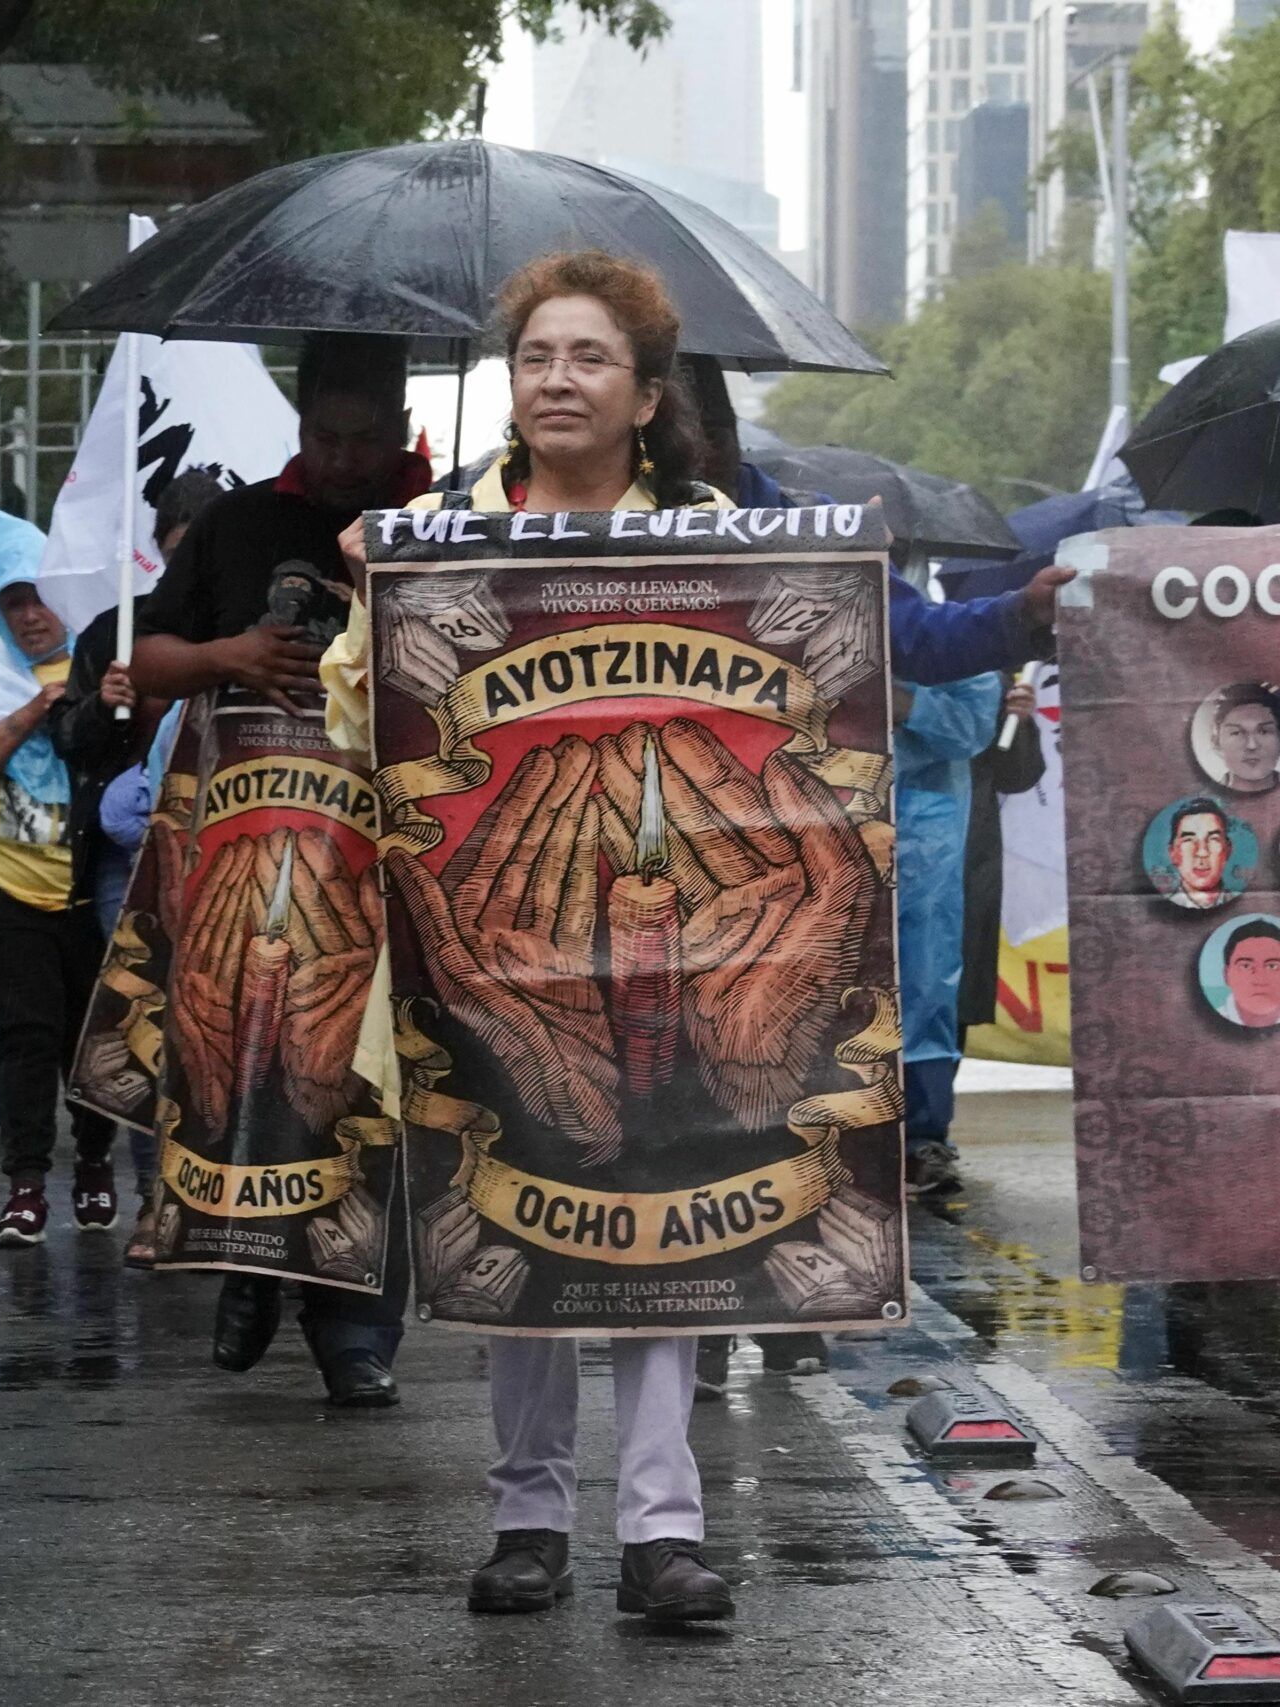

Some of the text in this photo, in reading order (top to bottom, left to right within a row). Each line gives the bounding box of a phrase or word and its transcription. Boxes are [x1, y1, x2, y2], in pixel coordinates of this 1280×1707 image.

[377, 508, 488, 545] FUE
[509, 511, 590, 541] EL
[542, 579, 719, 598] ¡VIVOS LOS LLEVARON,
[540, 595, 720, 615] VIVOS LOS QUEREMOS!
[439, 618, 482, 639] 26
[484, 640, 790, 718] AYOTZINAPA
[178, 1156, 324, 1207] OCHO AÑOS
[514, 1179, 786, 1250] OCHO AÑOS
[232, 1230, 285, 1246] SENTIDO
[603, 1282, 621, 1297] SE
[624, 1281, 660, 1297] HAN
[663, 1279, 736, 1295] SENTIDO
[552, 1299, 602, 1314] COMO
